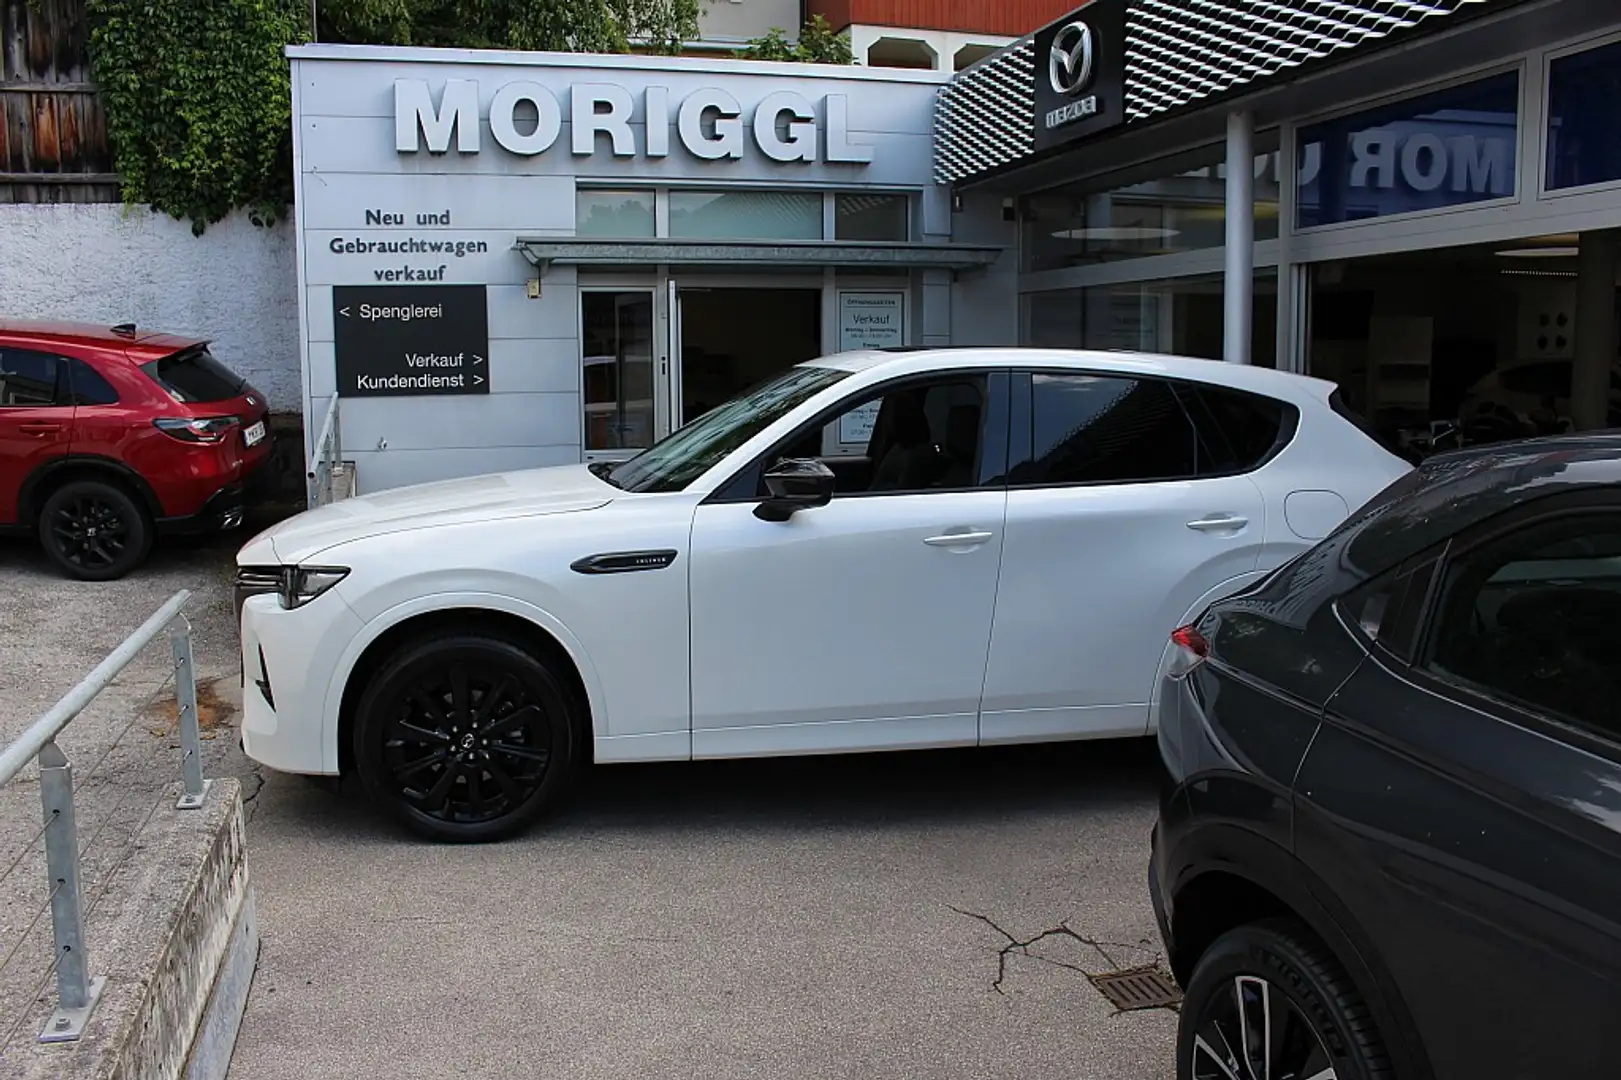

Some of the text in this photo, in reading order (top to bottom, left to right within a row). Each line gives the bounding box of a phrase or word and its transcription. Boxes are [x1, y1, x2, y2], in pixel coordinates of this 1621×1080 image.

[393, 78, 876, 164] MORIGGL
[365, 209, 451, 225] Neu und
[329, 237, 488, 258] Gebrauchtwagen
[374, 265, 447, 281] verkauf
[359, 303, 443, 322] Spenglerei
[852, 313, 890, 325] Verkauf
[405, 352, 464, 368] Verkauf
[357, 373, 465, 390] Kundendienst
